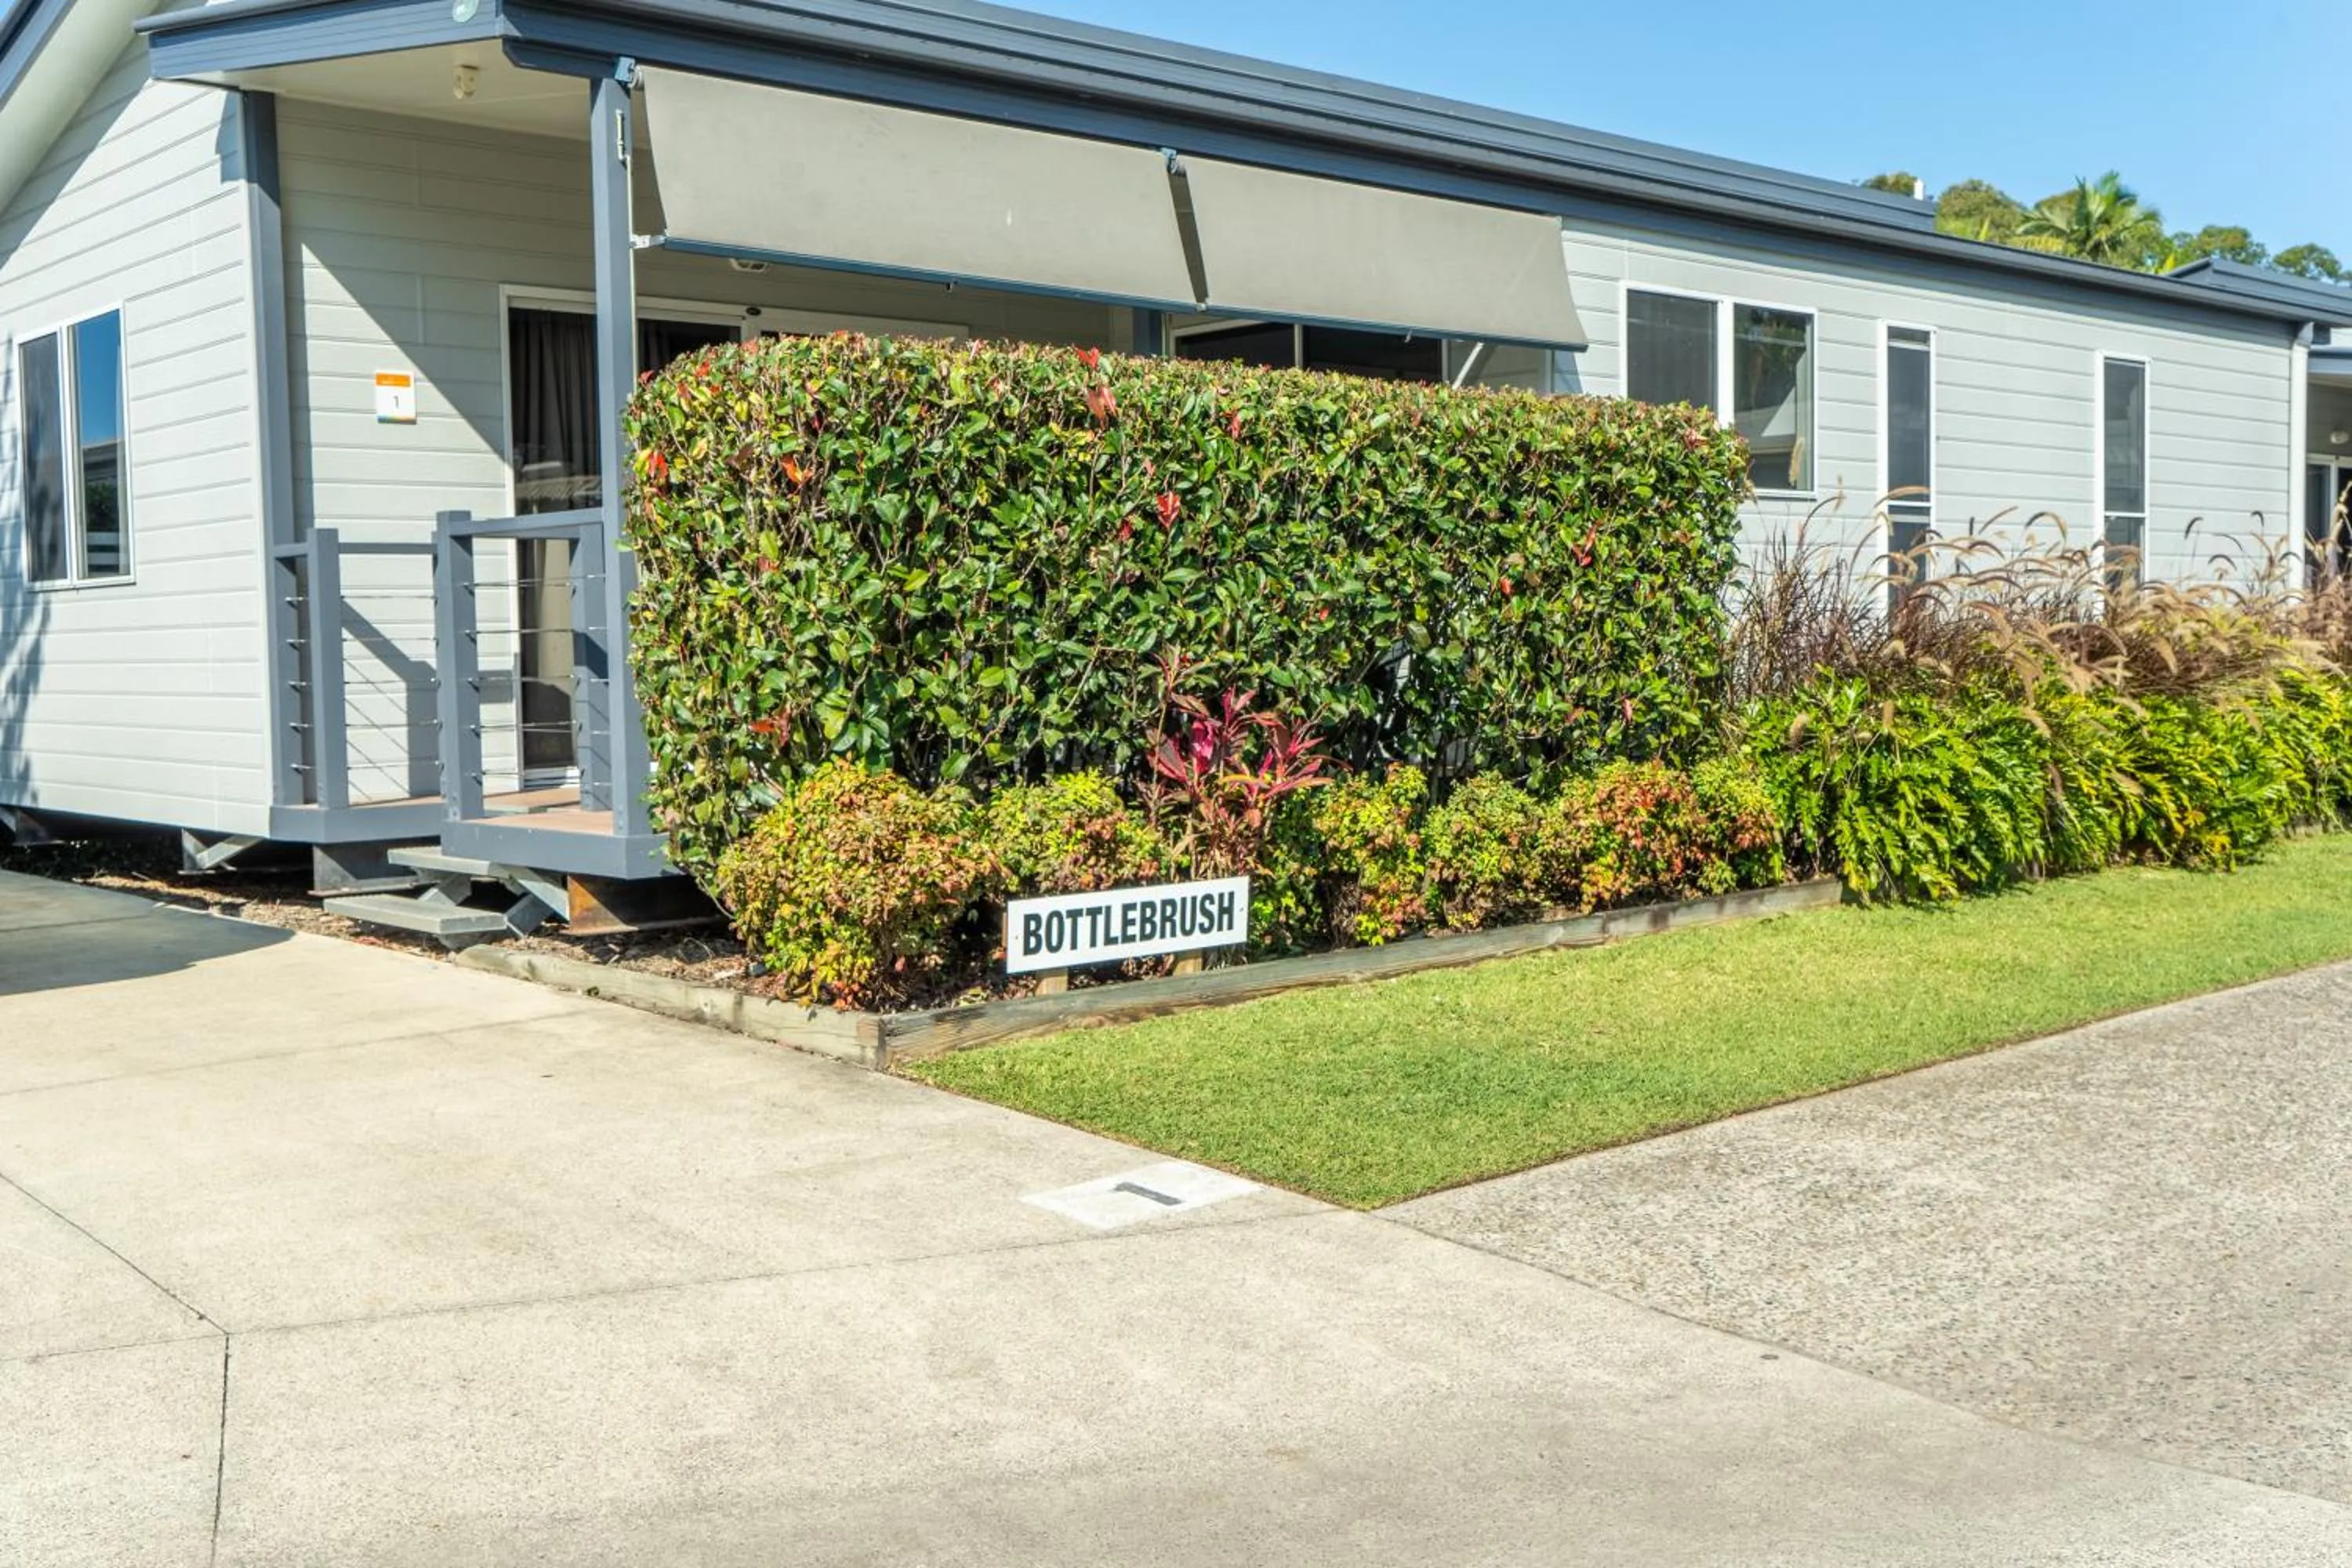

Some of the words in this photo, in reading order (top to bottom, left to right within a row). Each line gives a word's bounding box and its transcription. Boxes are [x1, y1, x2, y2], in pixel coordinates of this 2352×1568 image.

[393, 395, 399, 408] 1
[1023, 891, 1235, 956] BOTTLEBRUSH
[1111, 1181, 1183, 1206] 1
